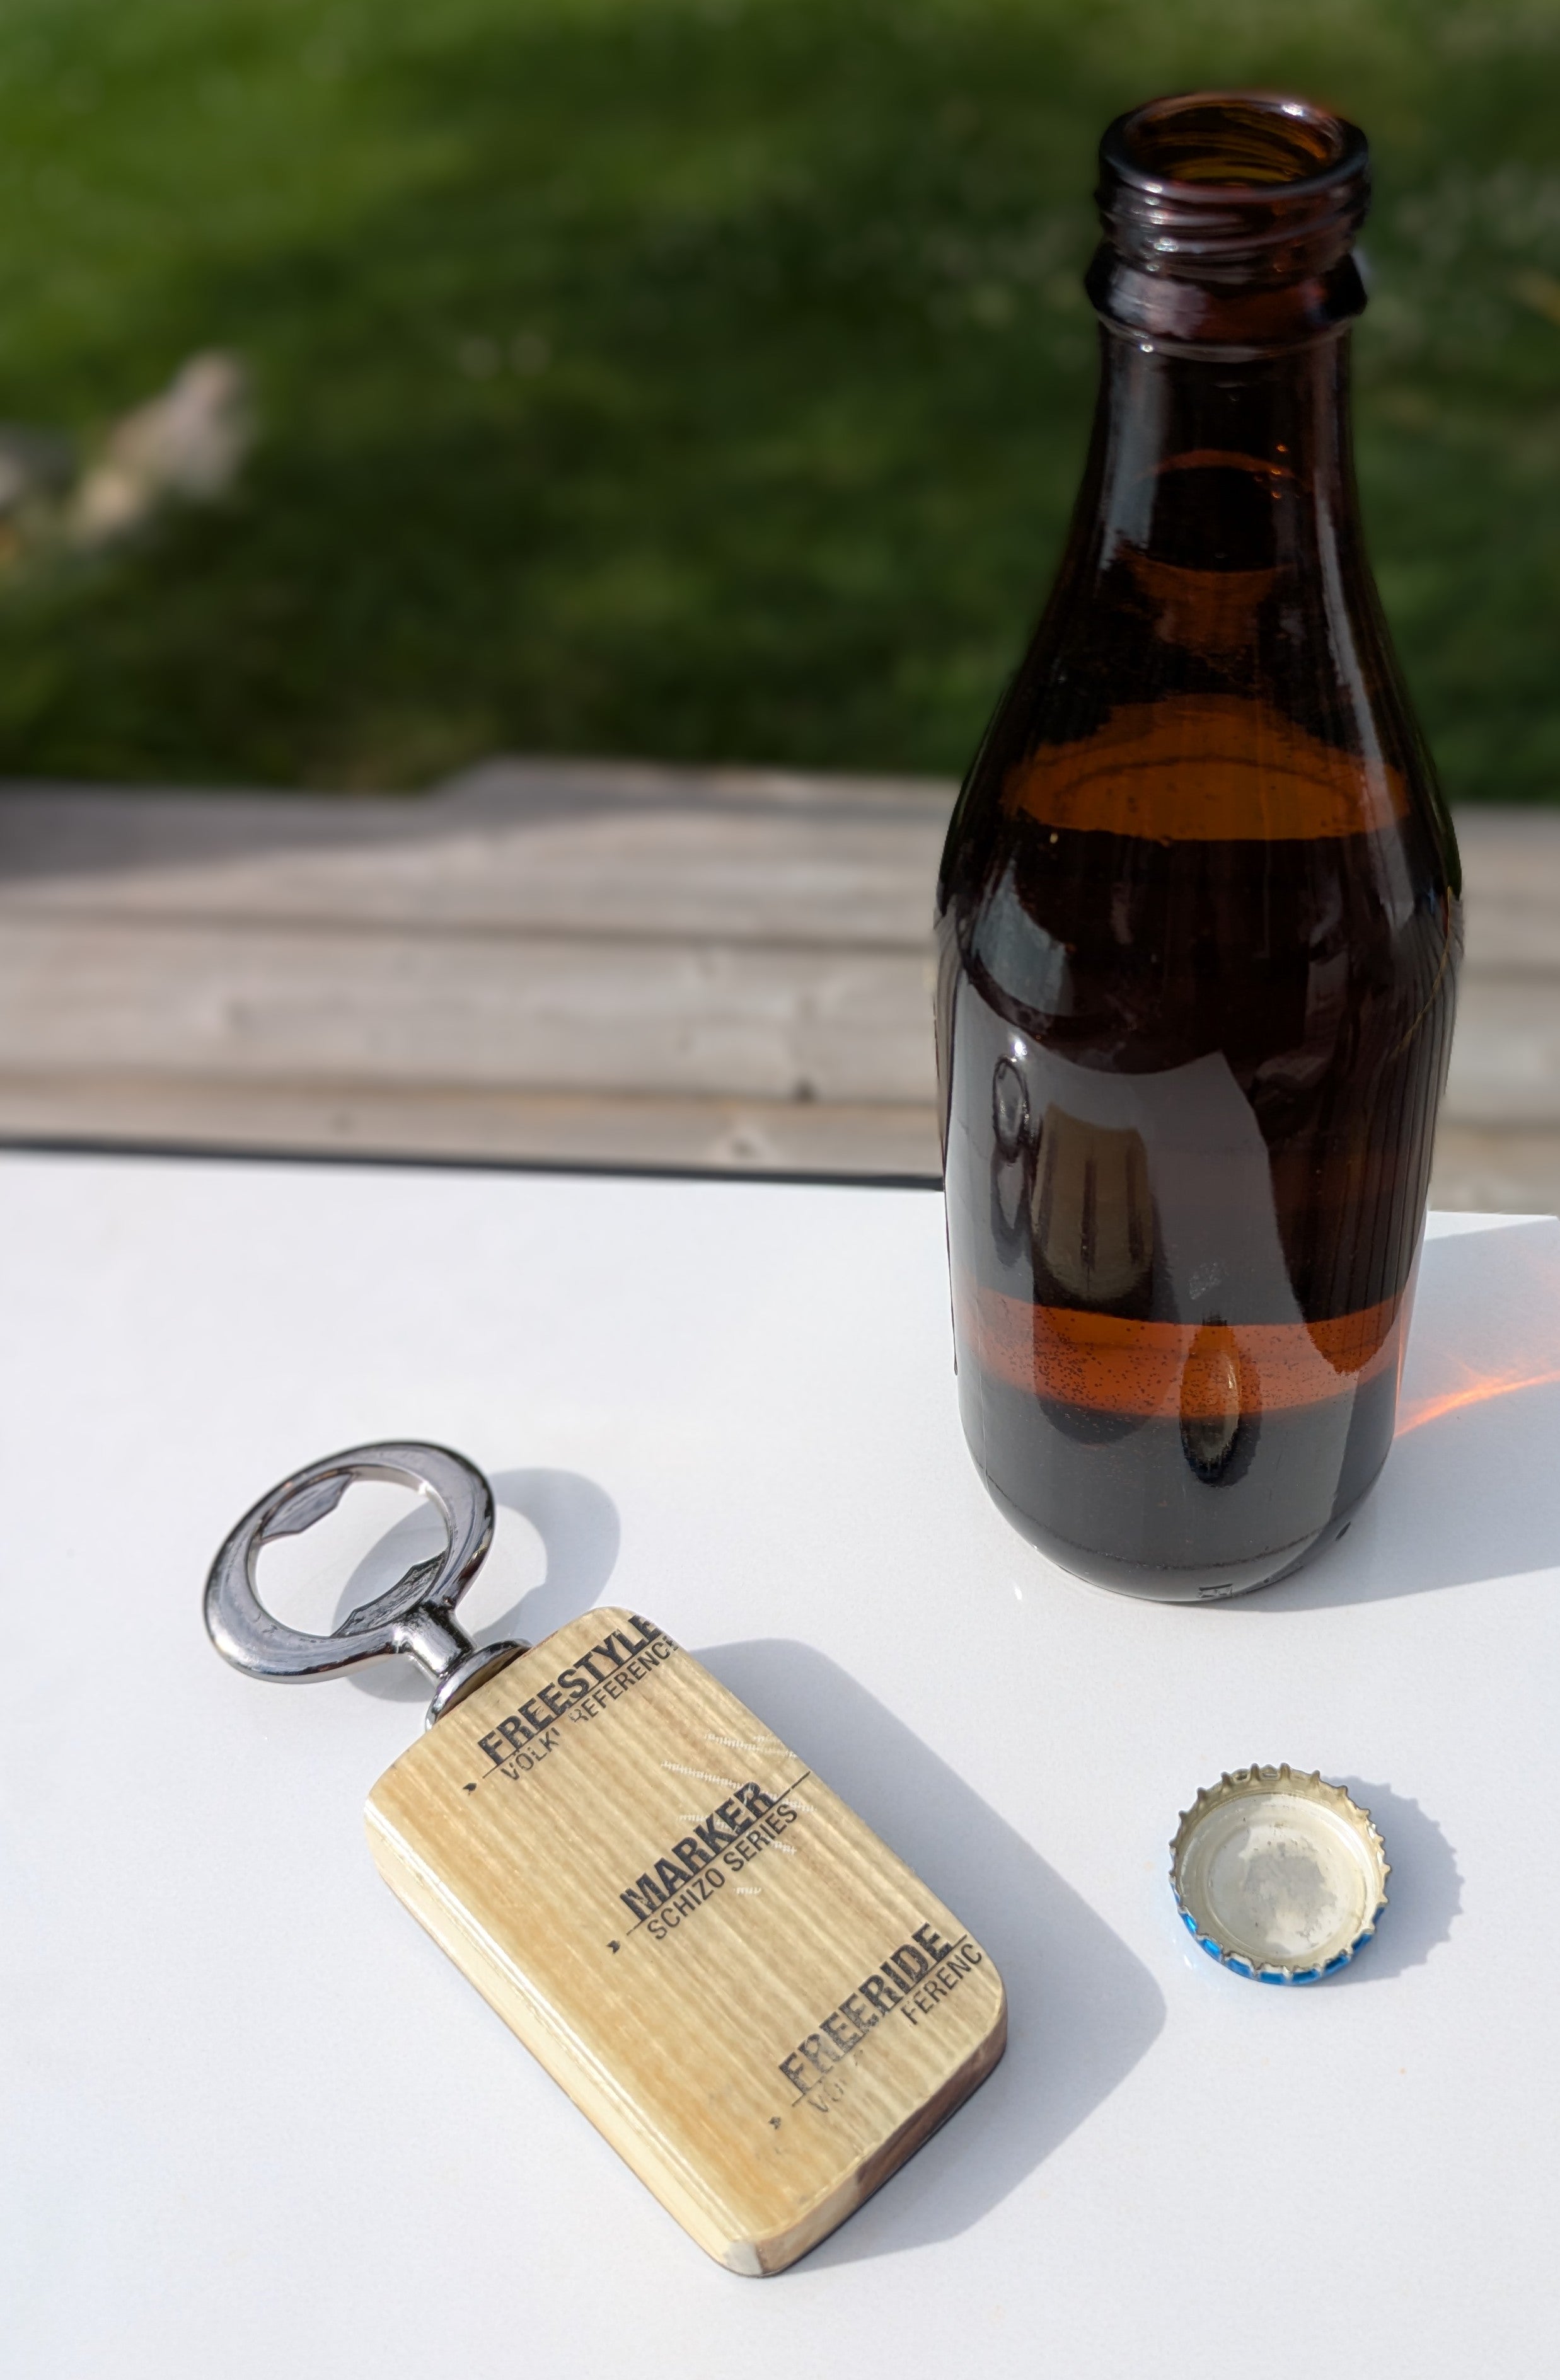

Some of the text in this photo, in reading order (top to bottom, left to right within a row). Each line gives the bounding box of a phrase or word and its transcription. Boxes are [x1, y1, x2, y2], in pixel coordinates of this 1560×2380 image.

[477, 1614, 663, 1765] FREESTYLE
[619, 1781, 776, 1922] MARKER
[647, 1803, 798, 1940] SCHIZO SERIES
[778, 1922, 955, 2095] FREERIDE
